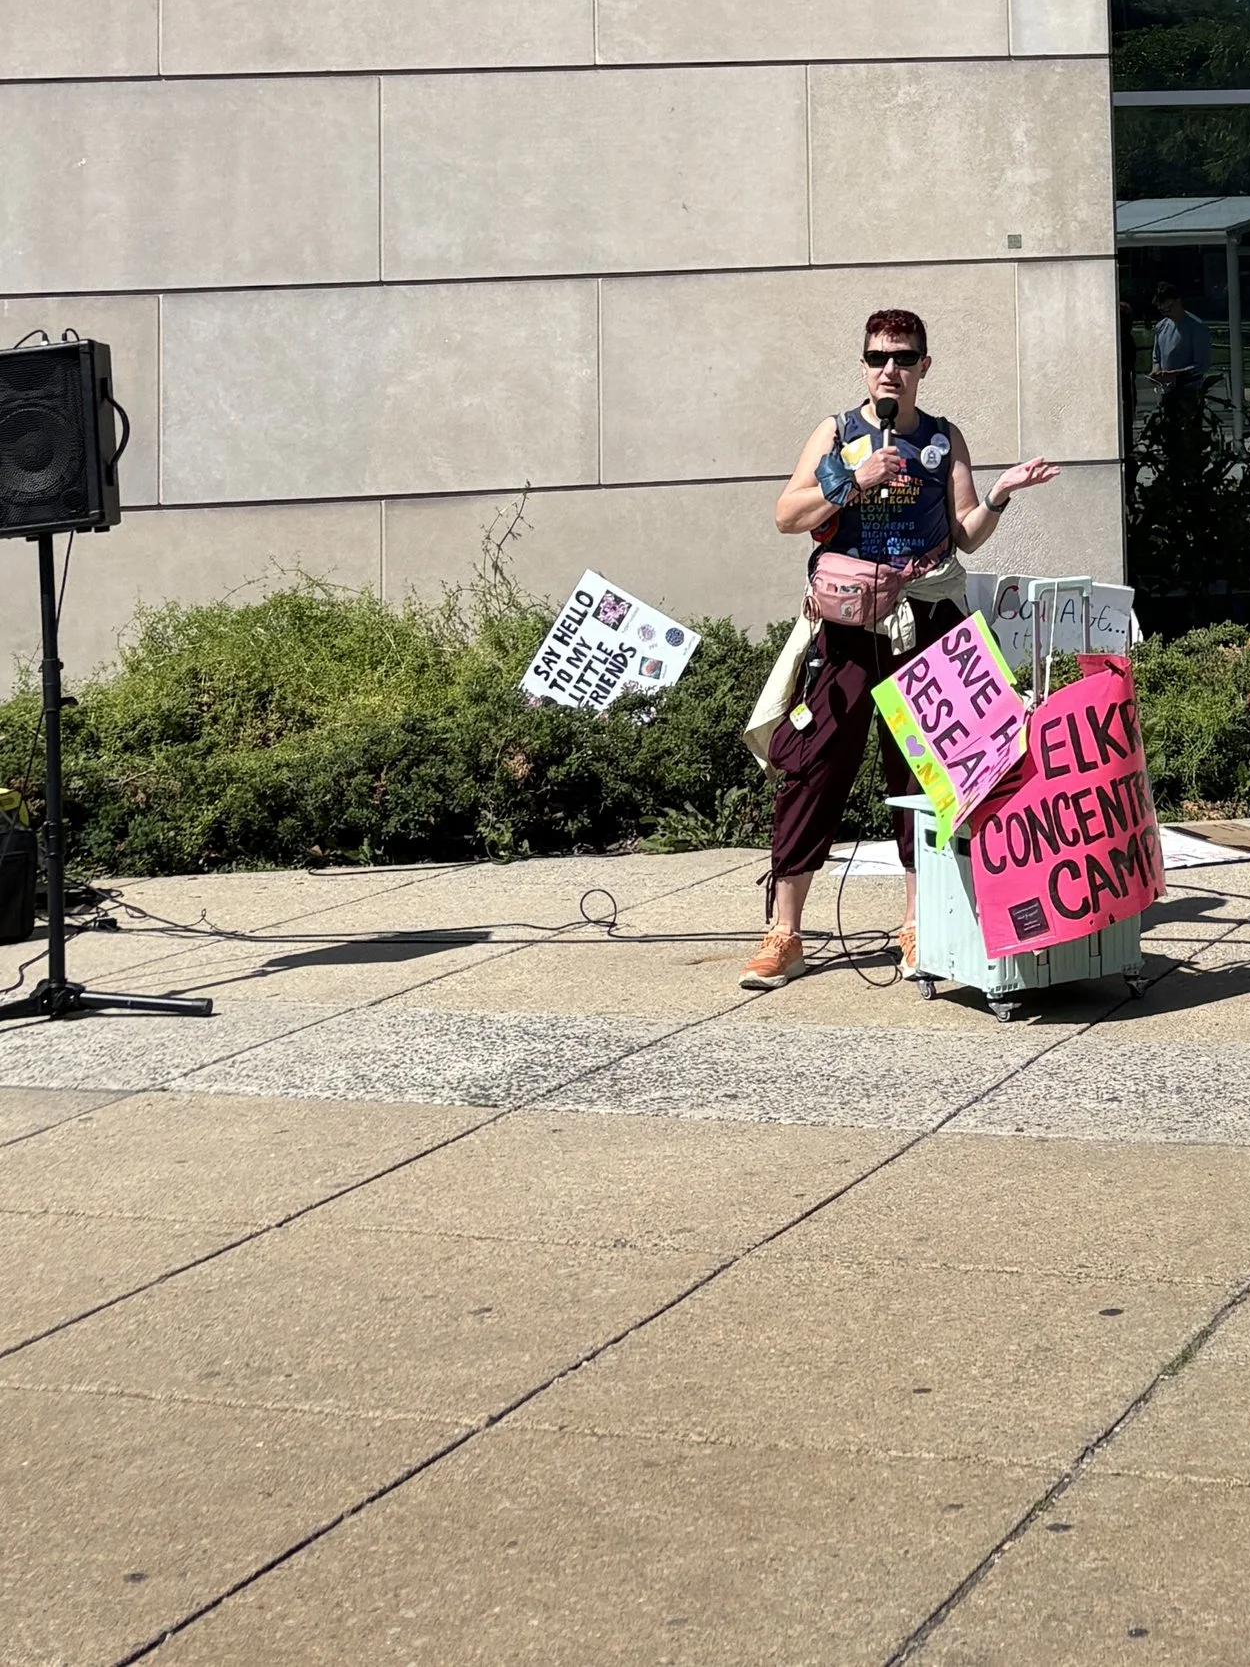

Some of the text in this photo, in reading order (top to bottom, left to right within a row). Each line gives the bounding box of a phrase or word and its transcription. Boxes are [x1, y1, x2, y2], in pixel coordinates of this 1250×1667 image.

[533, 590, 594, 681] SAY HELLO
[548, 636, 592, 693] TO MY
[568, 641, 614, 703] LITTLE
[941, 628, 1001, 719] SAVE
